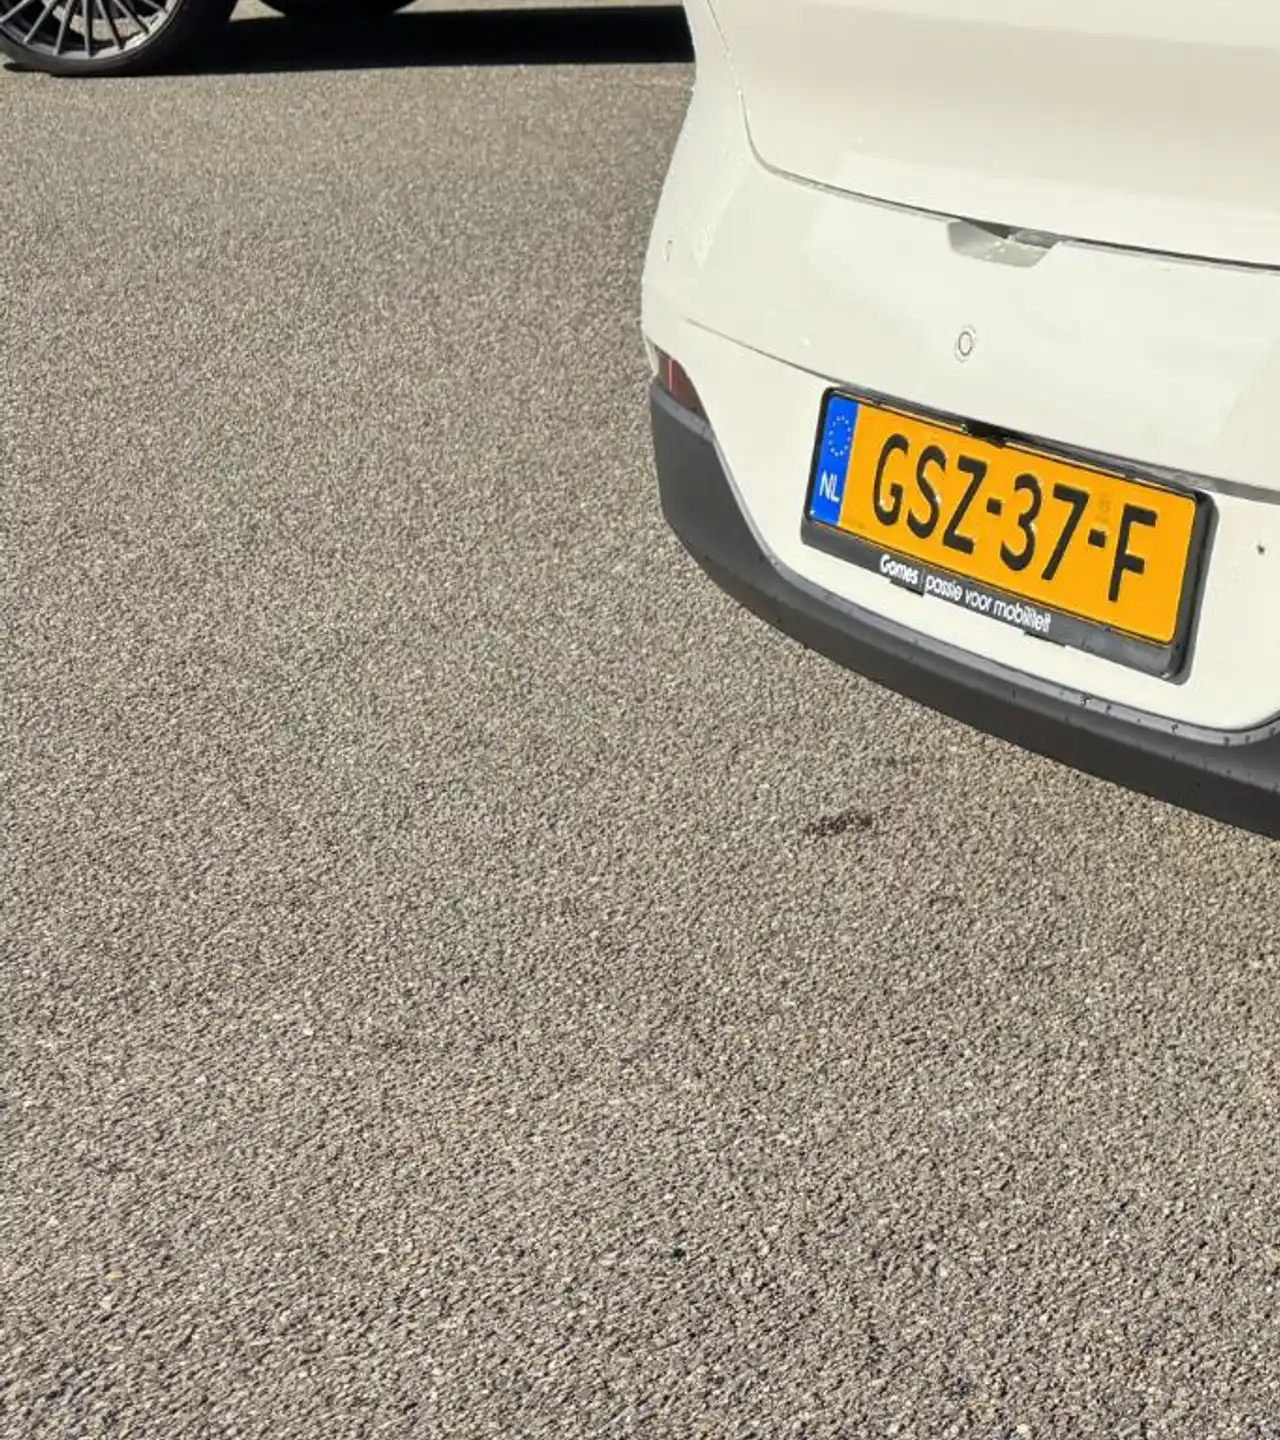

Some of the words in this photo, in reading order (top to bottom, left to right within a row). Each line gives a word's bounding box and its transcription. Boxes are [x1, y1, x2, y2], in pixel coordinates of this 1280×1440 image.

[819, 470, 841, 502] NL
[872, 432, 1158, 602] GSZ-37-F
[925, 575, 963, 601] passie
[965, 588, 992, 611] voor
[994, 600, 1052, 633] mobiliteit
